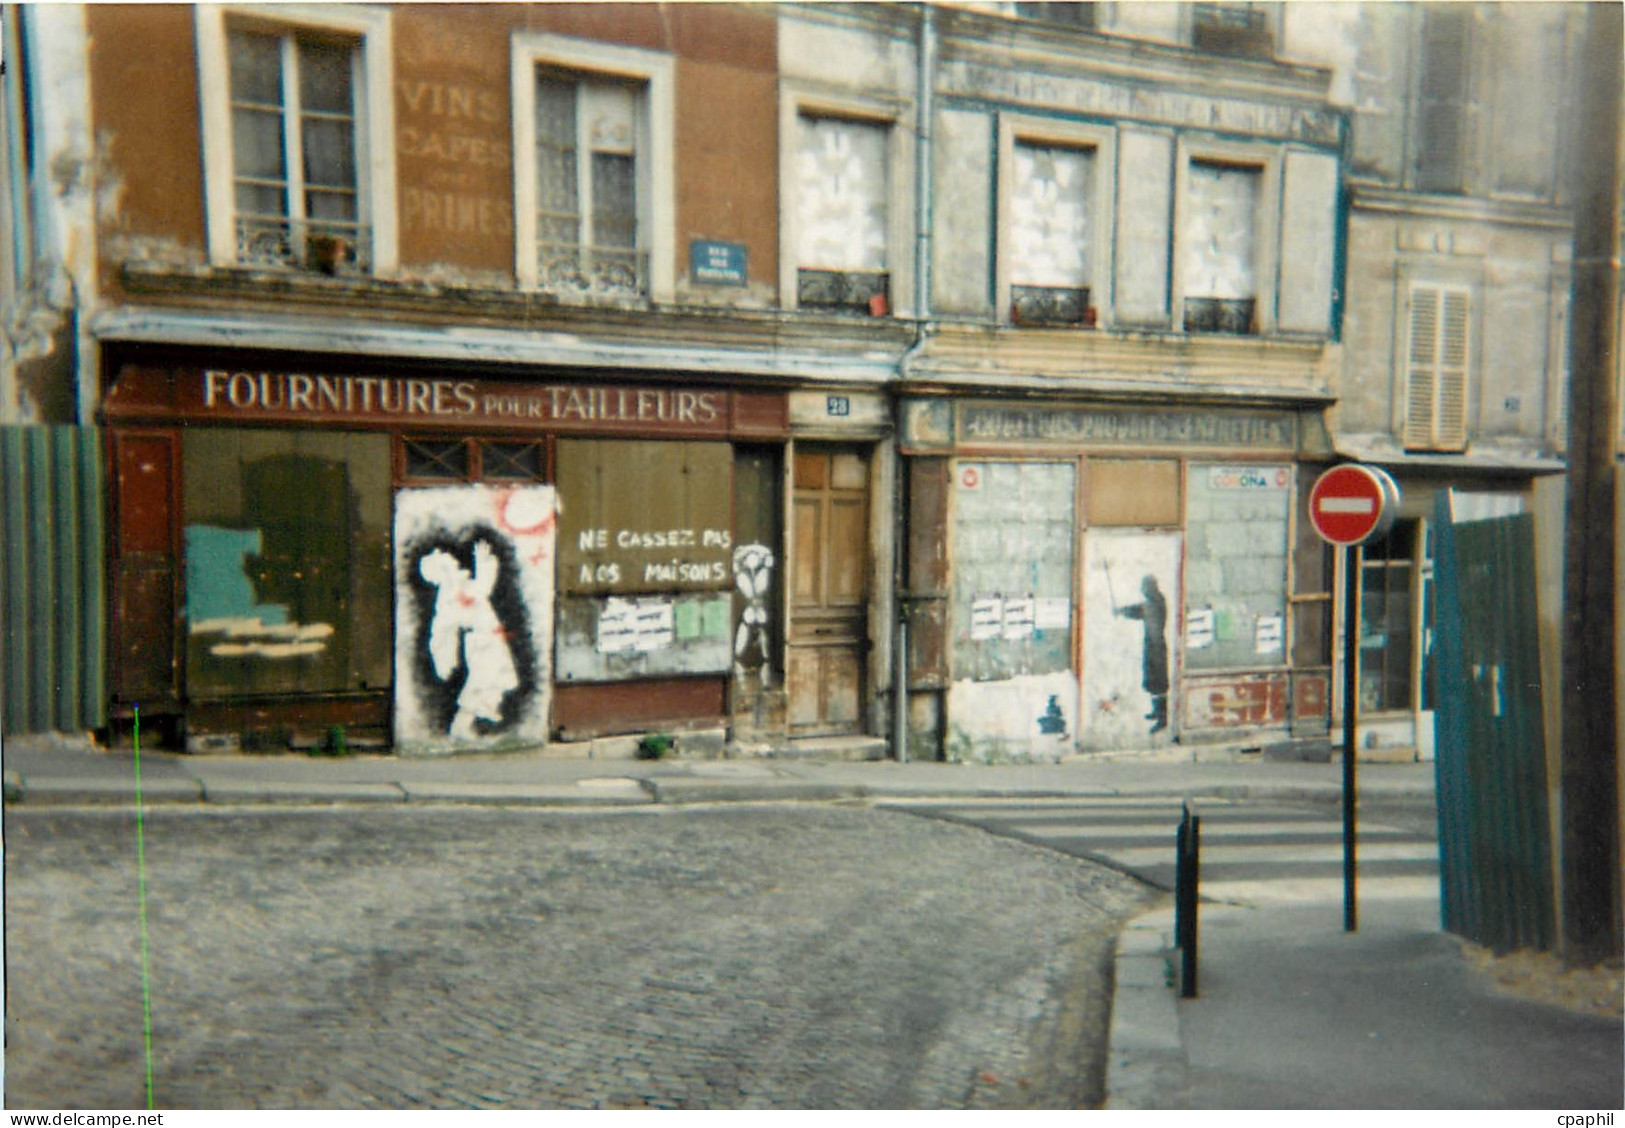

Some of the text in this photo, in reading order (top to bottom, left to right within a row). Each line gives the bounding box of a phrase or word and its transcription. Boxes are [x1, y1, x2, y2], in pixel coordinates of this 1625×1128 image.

[402, 82, 500, 122] VINS
[204, 370, 718, 424] FOURNITURES POUR TAILLEURS
[579, 529, 732, 551] NE CASSEZ PAS
[580, 561, 622, 584] NOS
